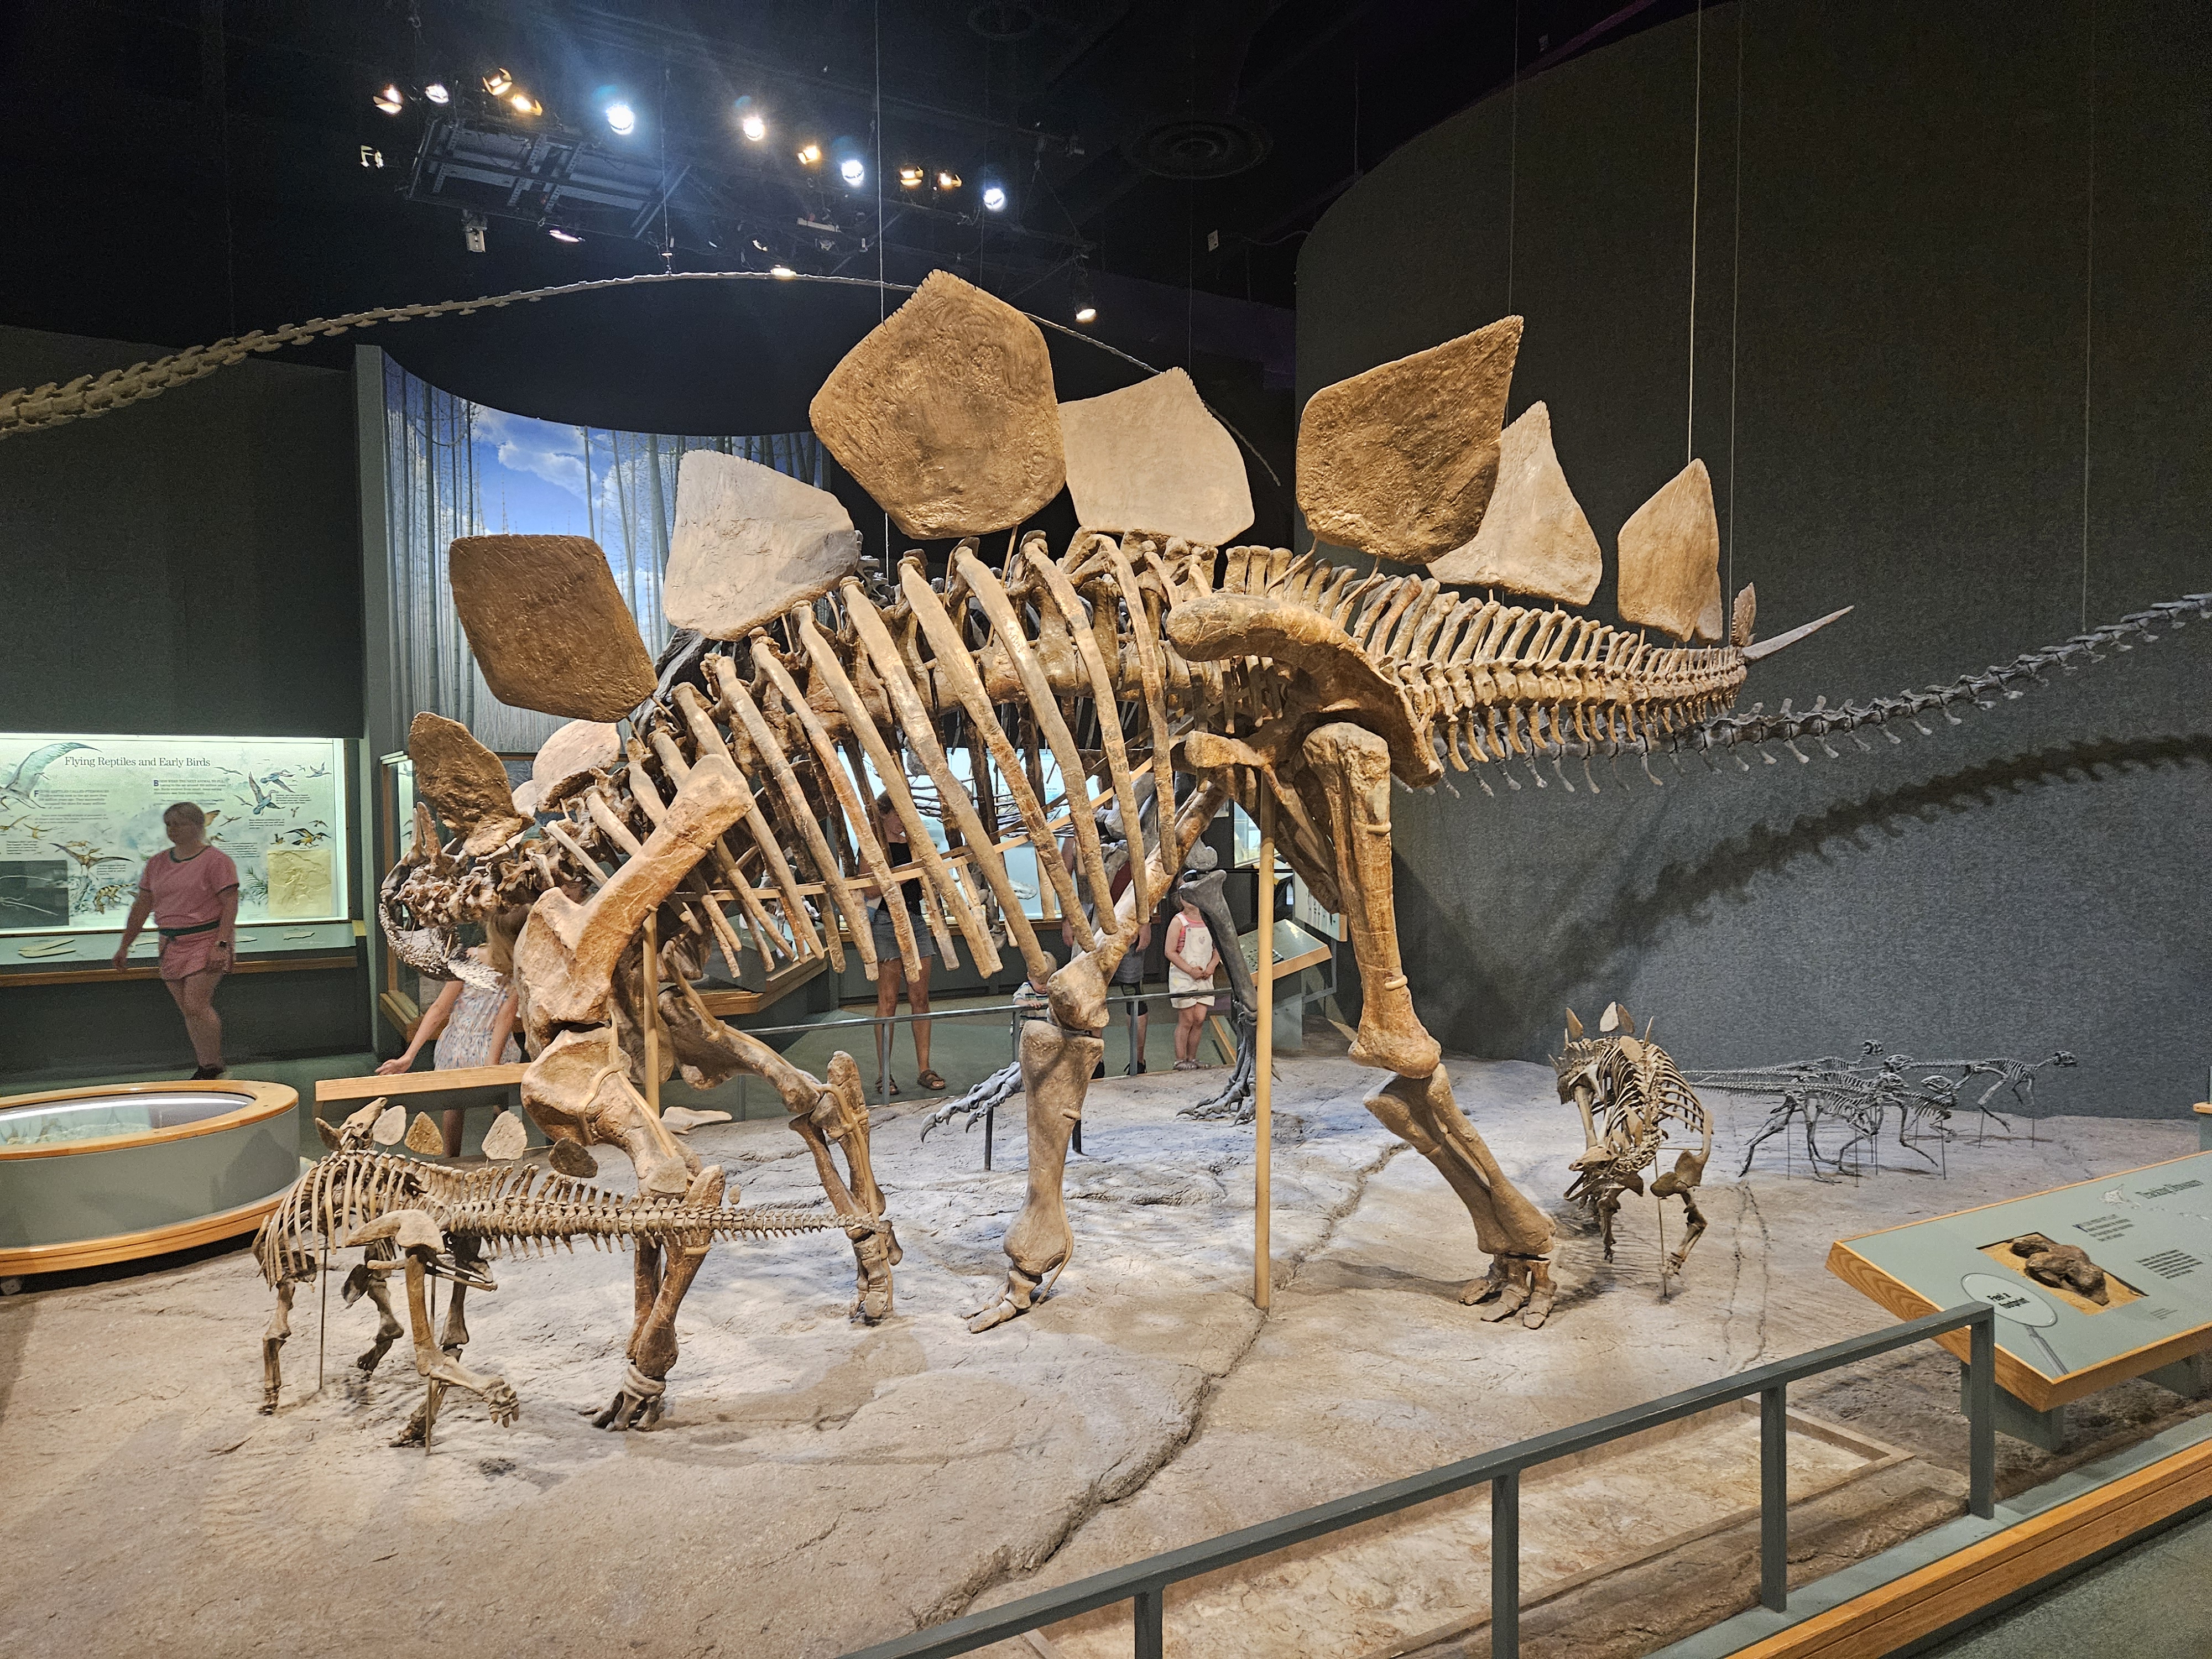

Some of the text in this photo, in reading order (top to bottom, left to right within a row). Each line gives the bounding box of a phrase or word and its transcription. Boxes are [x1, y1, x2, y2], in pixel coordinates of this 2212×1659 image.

[65, 757, 211, 768] Flying Reptiles and Early Birds
[1986, 1293, 2006, 1302] Feel
[1999, 1297, 2030, 1309] footprint
